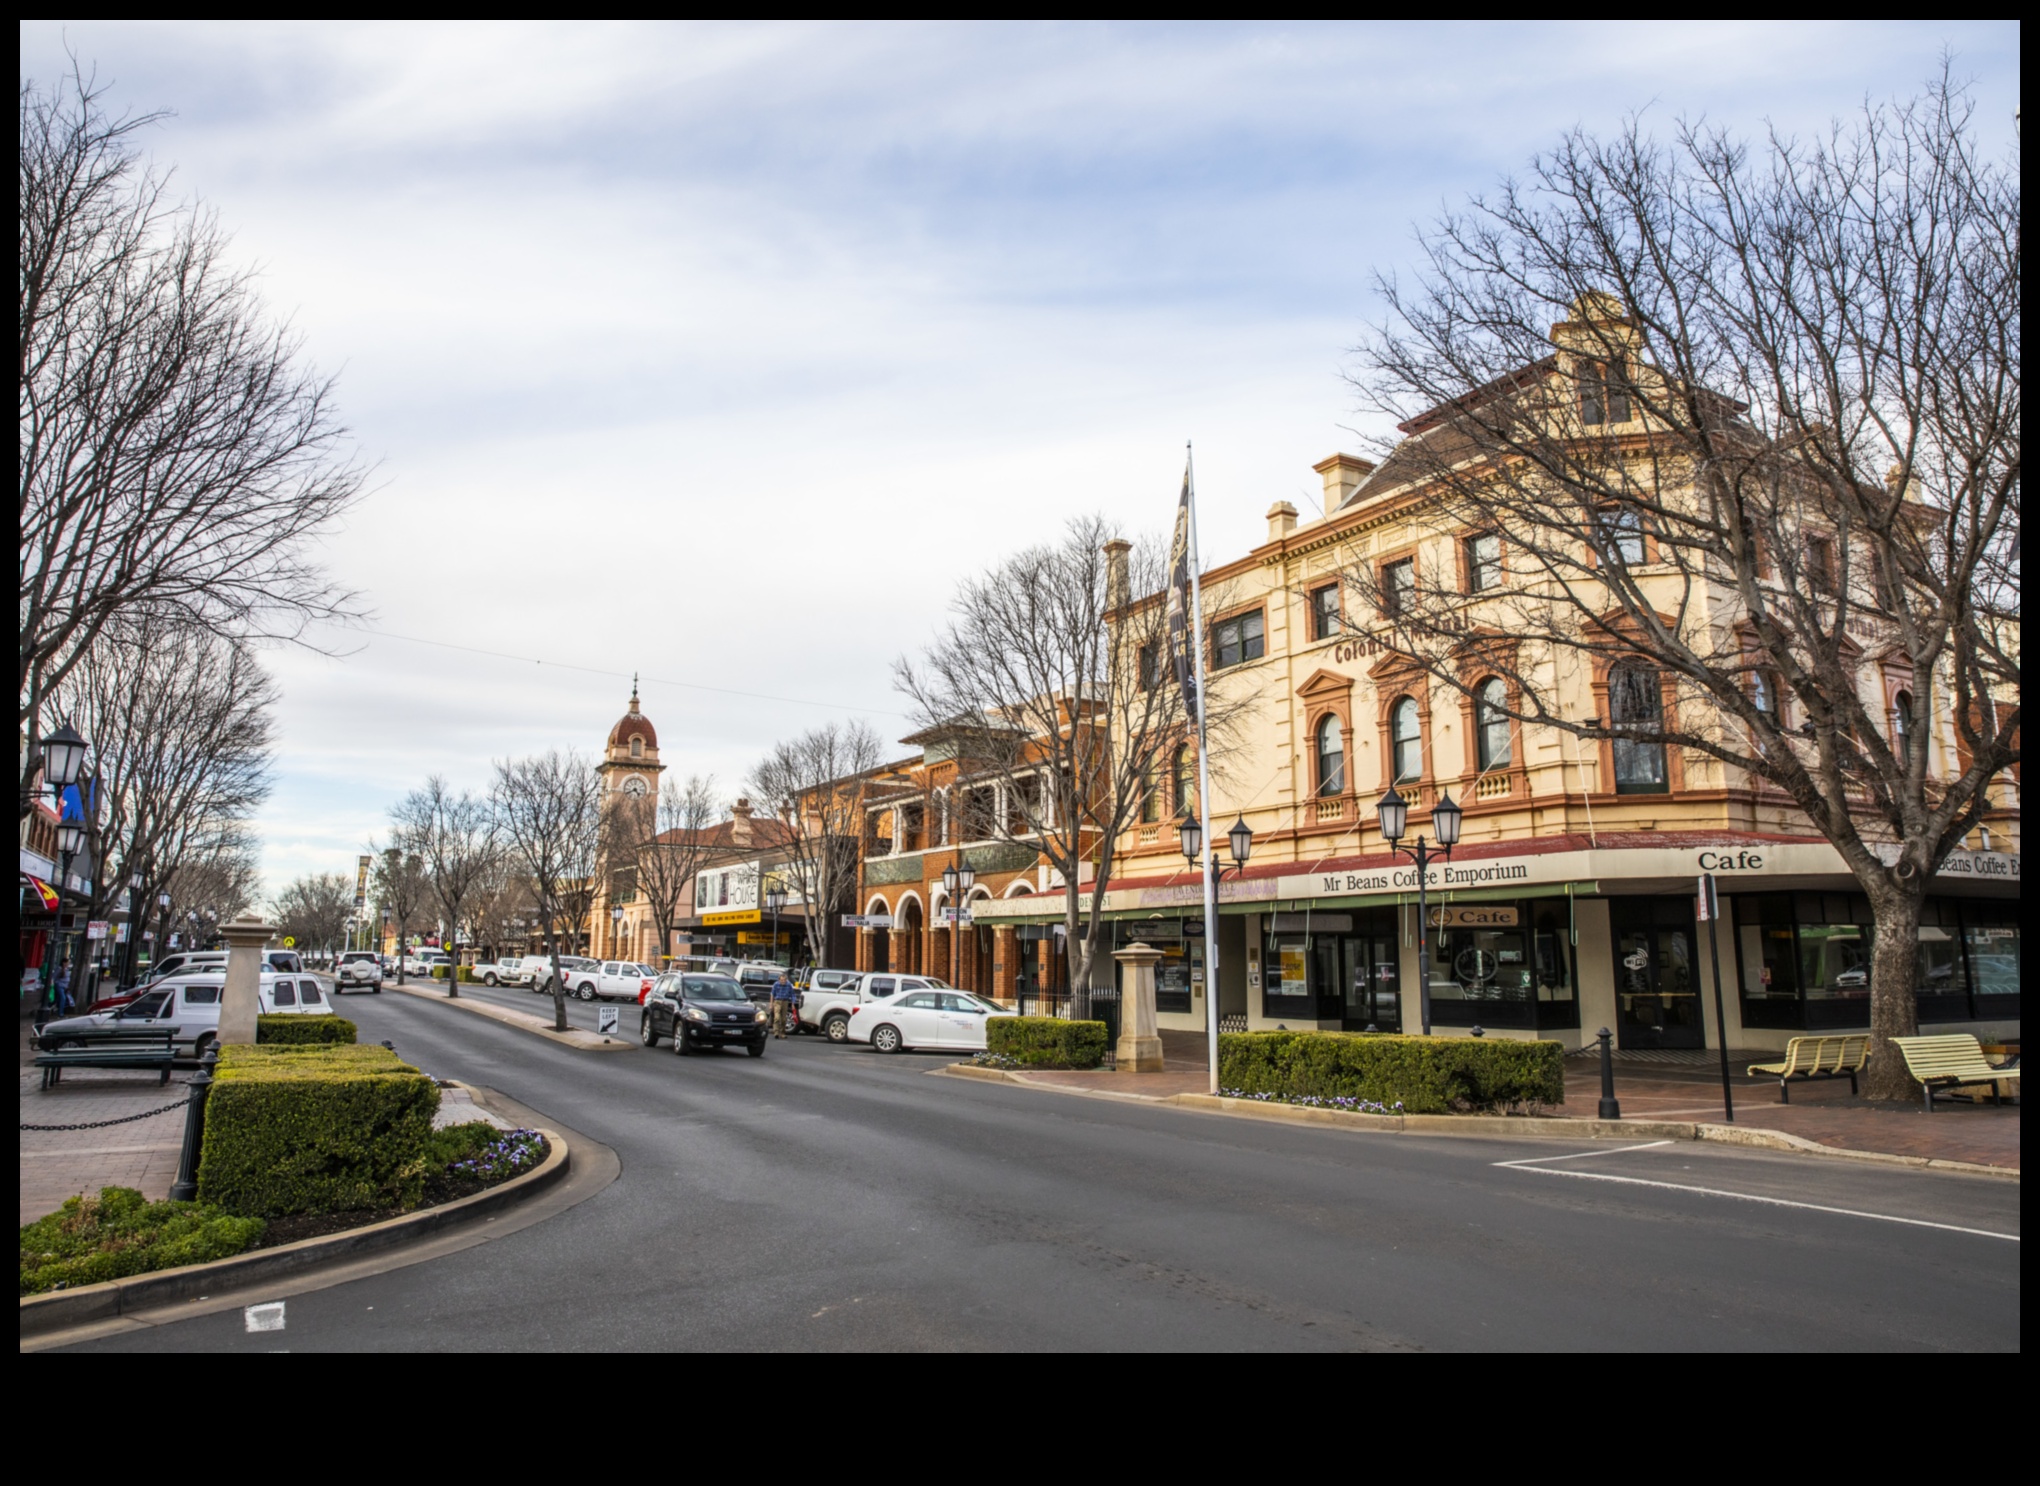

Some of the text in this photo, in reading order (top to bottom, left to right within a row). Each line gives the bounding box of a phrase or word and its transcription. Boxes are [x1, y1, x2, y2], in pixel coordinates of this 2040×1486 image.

[1334, 629, 1397, 664] Colonial
[1698, 851, 1763, 870] Cafe
[1974, 856, 2007, 875] Coffee
[1323, 862, 1528, 892] Mr Beans Coffee Emporium
[729, 884, 756, 905] HOUSE
[1459, 911, 1511, 923] Cafe
